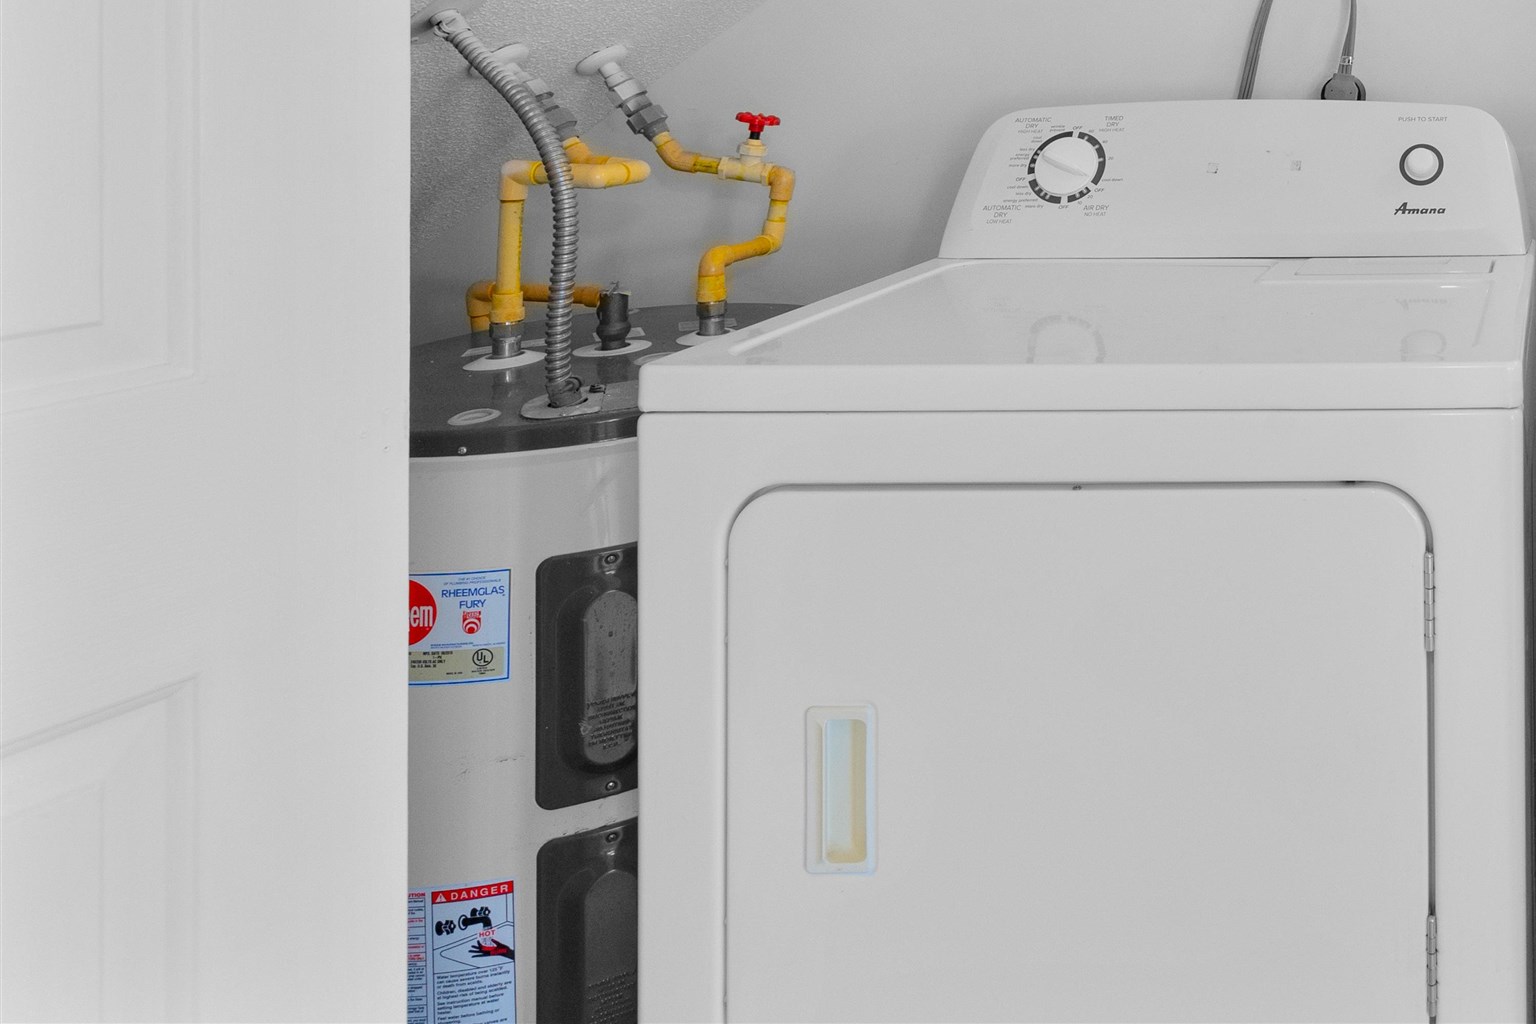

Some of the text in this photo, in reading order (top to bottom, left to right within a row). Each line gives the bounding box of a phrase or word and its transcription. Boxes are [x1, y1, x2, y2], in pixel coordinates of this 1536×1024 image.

[1394, 202, 1446, 216] Amana
[441, 585, 505, 598] RHEEMGLAS
[459, 599, 486, 609] FURY
[410, 605, 434, 628] em
[450, 884, 508, 900] DANGER
